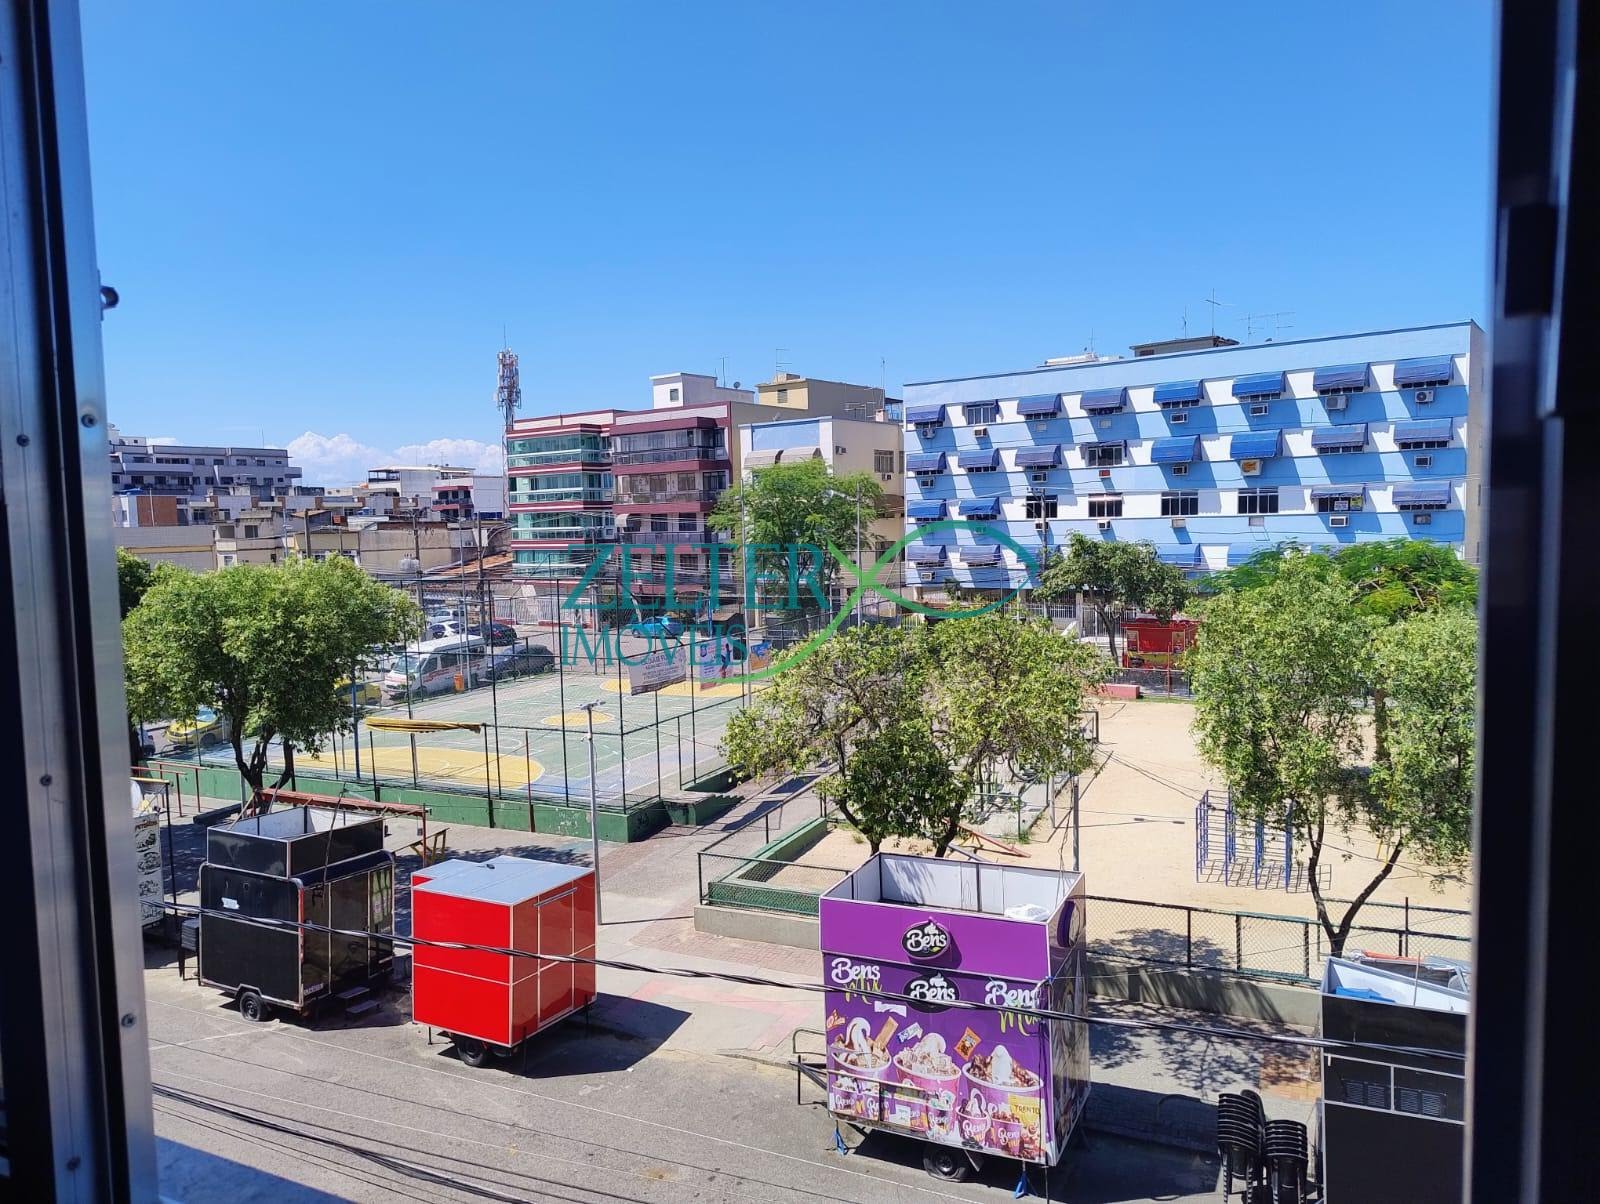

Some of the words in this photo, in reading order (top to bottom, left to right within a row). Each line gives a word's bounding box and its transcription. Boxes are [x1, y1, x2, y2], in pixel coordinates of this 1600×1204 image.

[906, 929, 947, 952] Bens
[831, 957, 880, 984] Bens
[910, 980, 956, 1003] Bens
[1015, 1104, 1040, 1114] TRENTO
